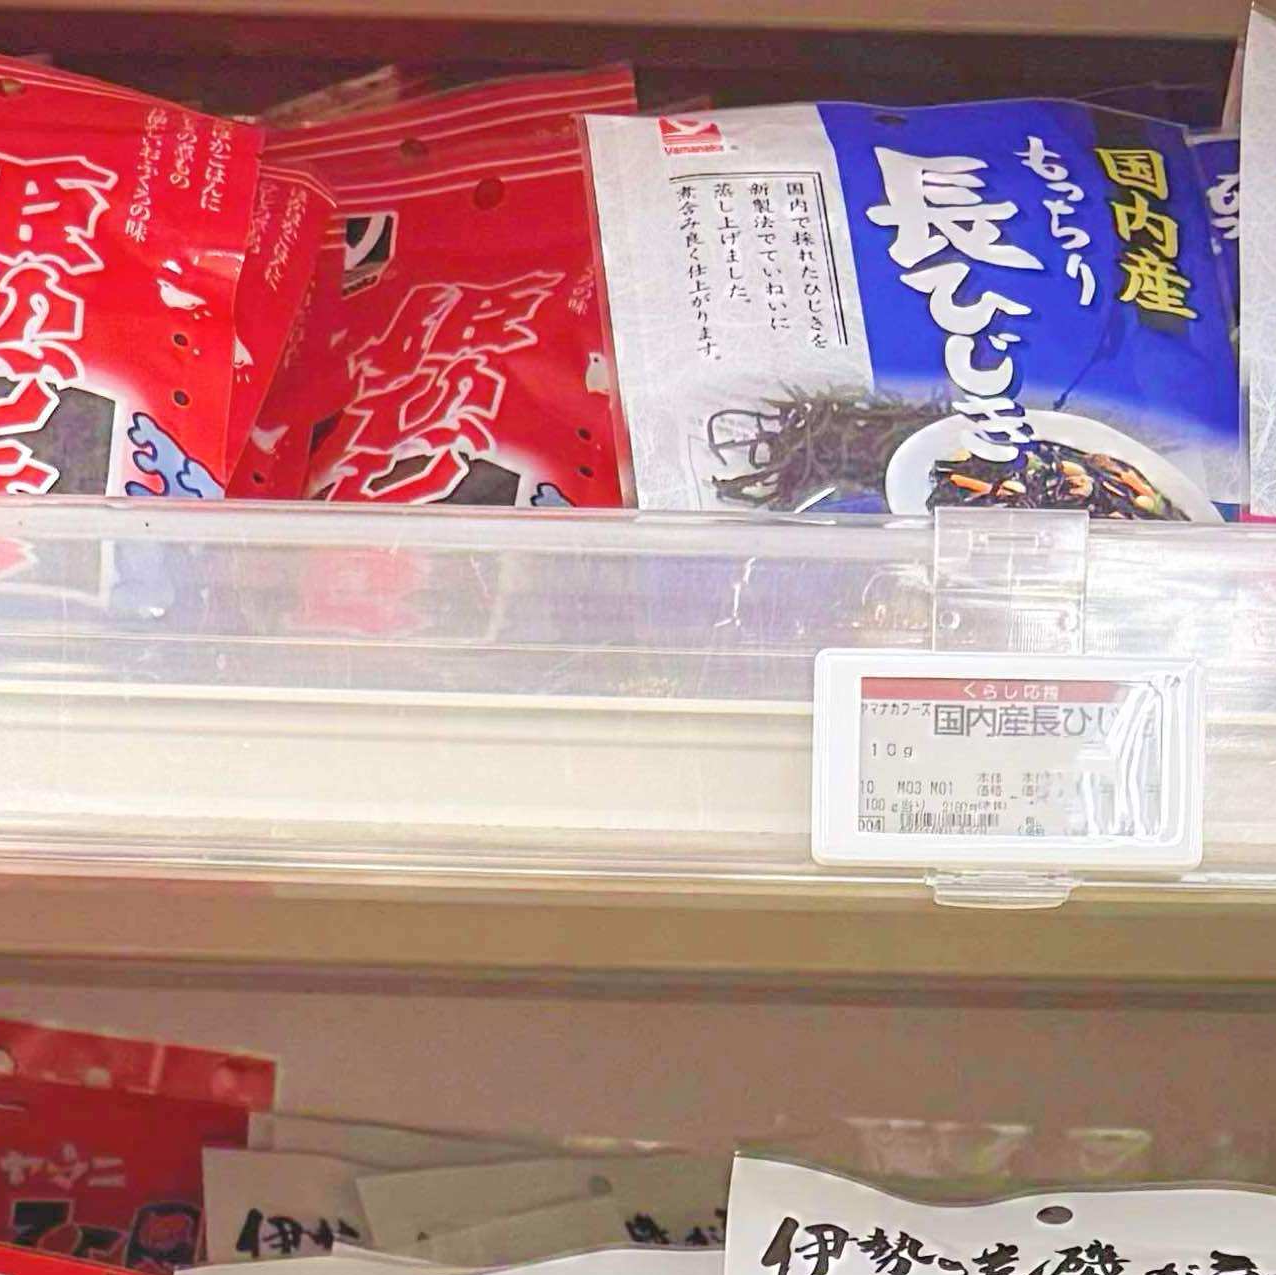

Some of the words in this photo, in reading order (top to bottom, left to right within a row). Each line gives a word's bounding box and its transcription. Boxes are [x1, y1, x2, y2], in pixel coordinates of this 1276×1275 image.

[713, 183, 752, 303] 蒸し上げました。
[748, 183, 791, 331] 新製法でていねいに
[786, 182, 828, 350] 国内で採れたひじきを
[867, 146, 1044, 463] 長ひじき
[1013, 136, 1096, 306] もっちり
[1094, 148, 1197, 319] 国内産
[870, 743, 914, 759] 10g
